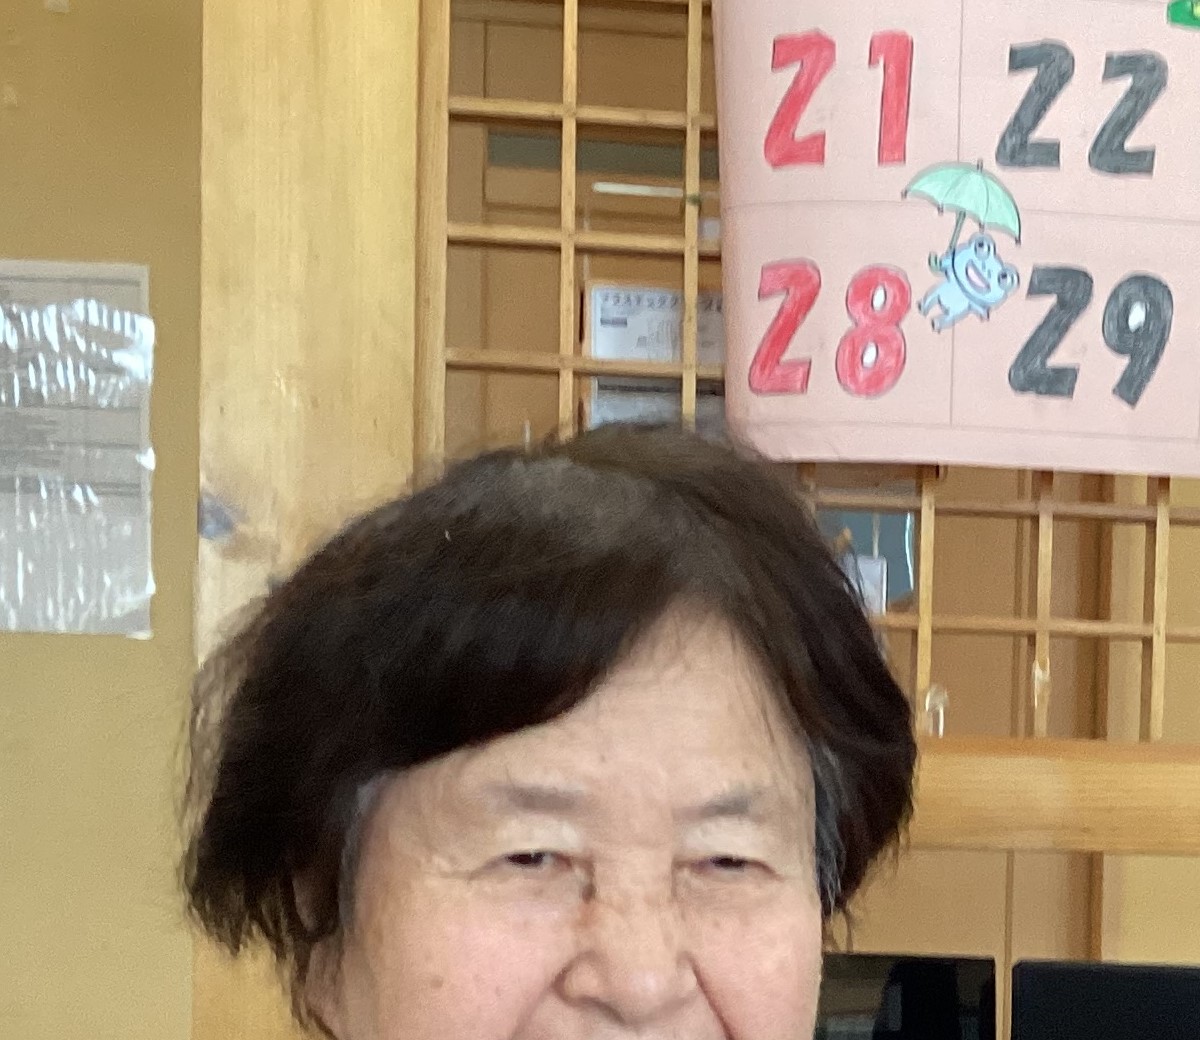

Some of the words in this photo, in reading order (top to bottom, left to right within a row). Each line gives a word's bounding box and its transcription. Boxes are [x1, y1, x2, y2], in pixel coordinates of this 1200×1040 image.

[764, 29, 913, 169] 21
[994, 39, 1168, 175] 22
[748, 259, 912, 397] 28
[1008, 265, 1174, 408] 29
